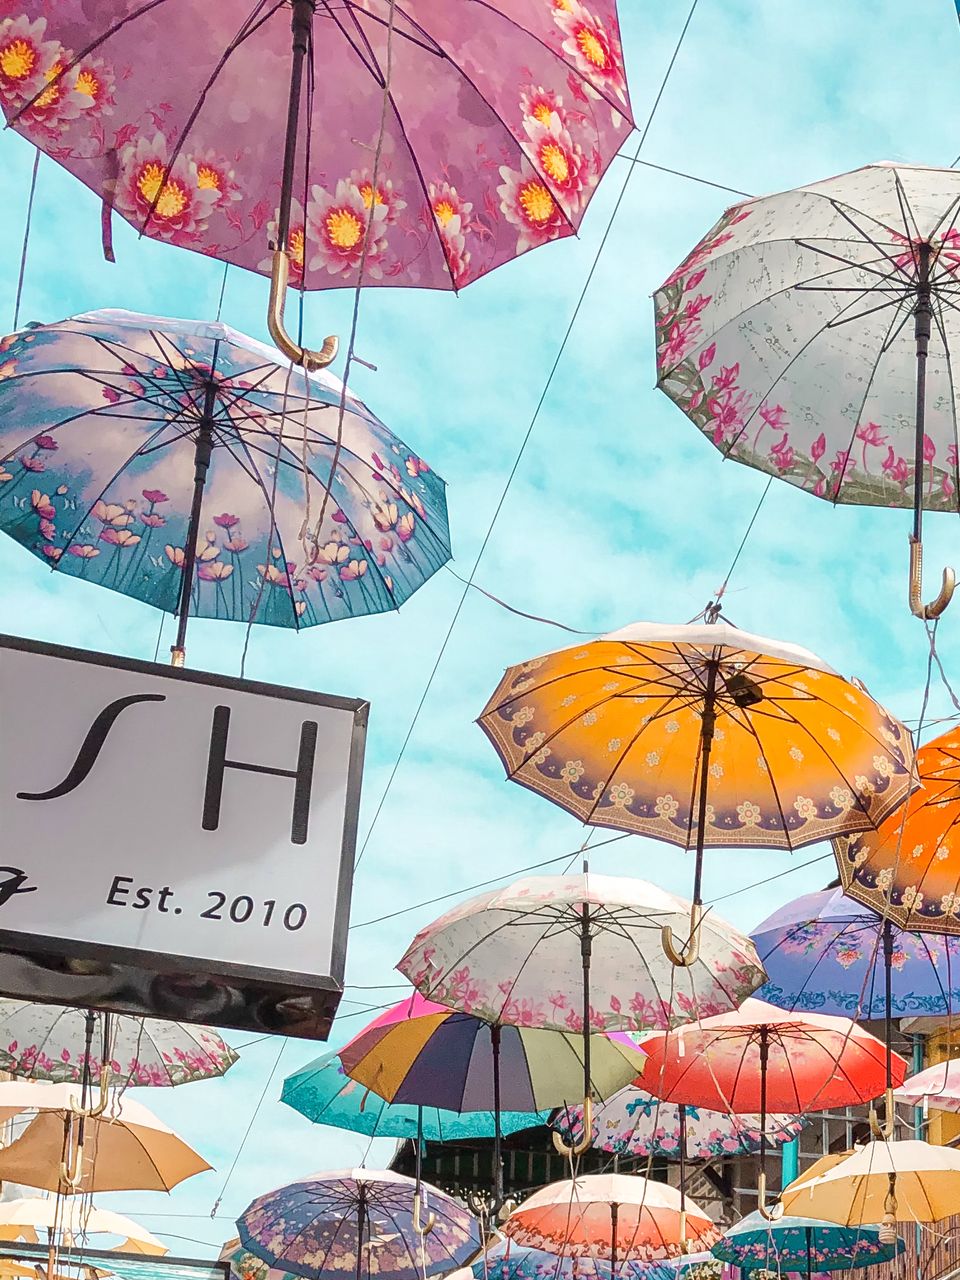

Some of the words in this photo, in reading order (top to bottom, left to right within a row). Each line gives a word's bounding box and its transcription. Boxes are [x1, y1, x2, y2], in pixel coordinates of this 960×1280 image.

[17, 693, 319, 844] SH
[106, 875, 183, 915] Est.
[200, 891, 308, 932] 2010
